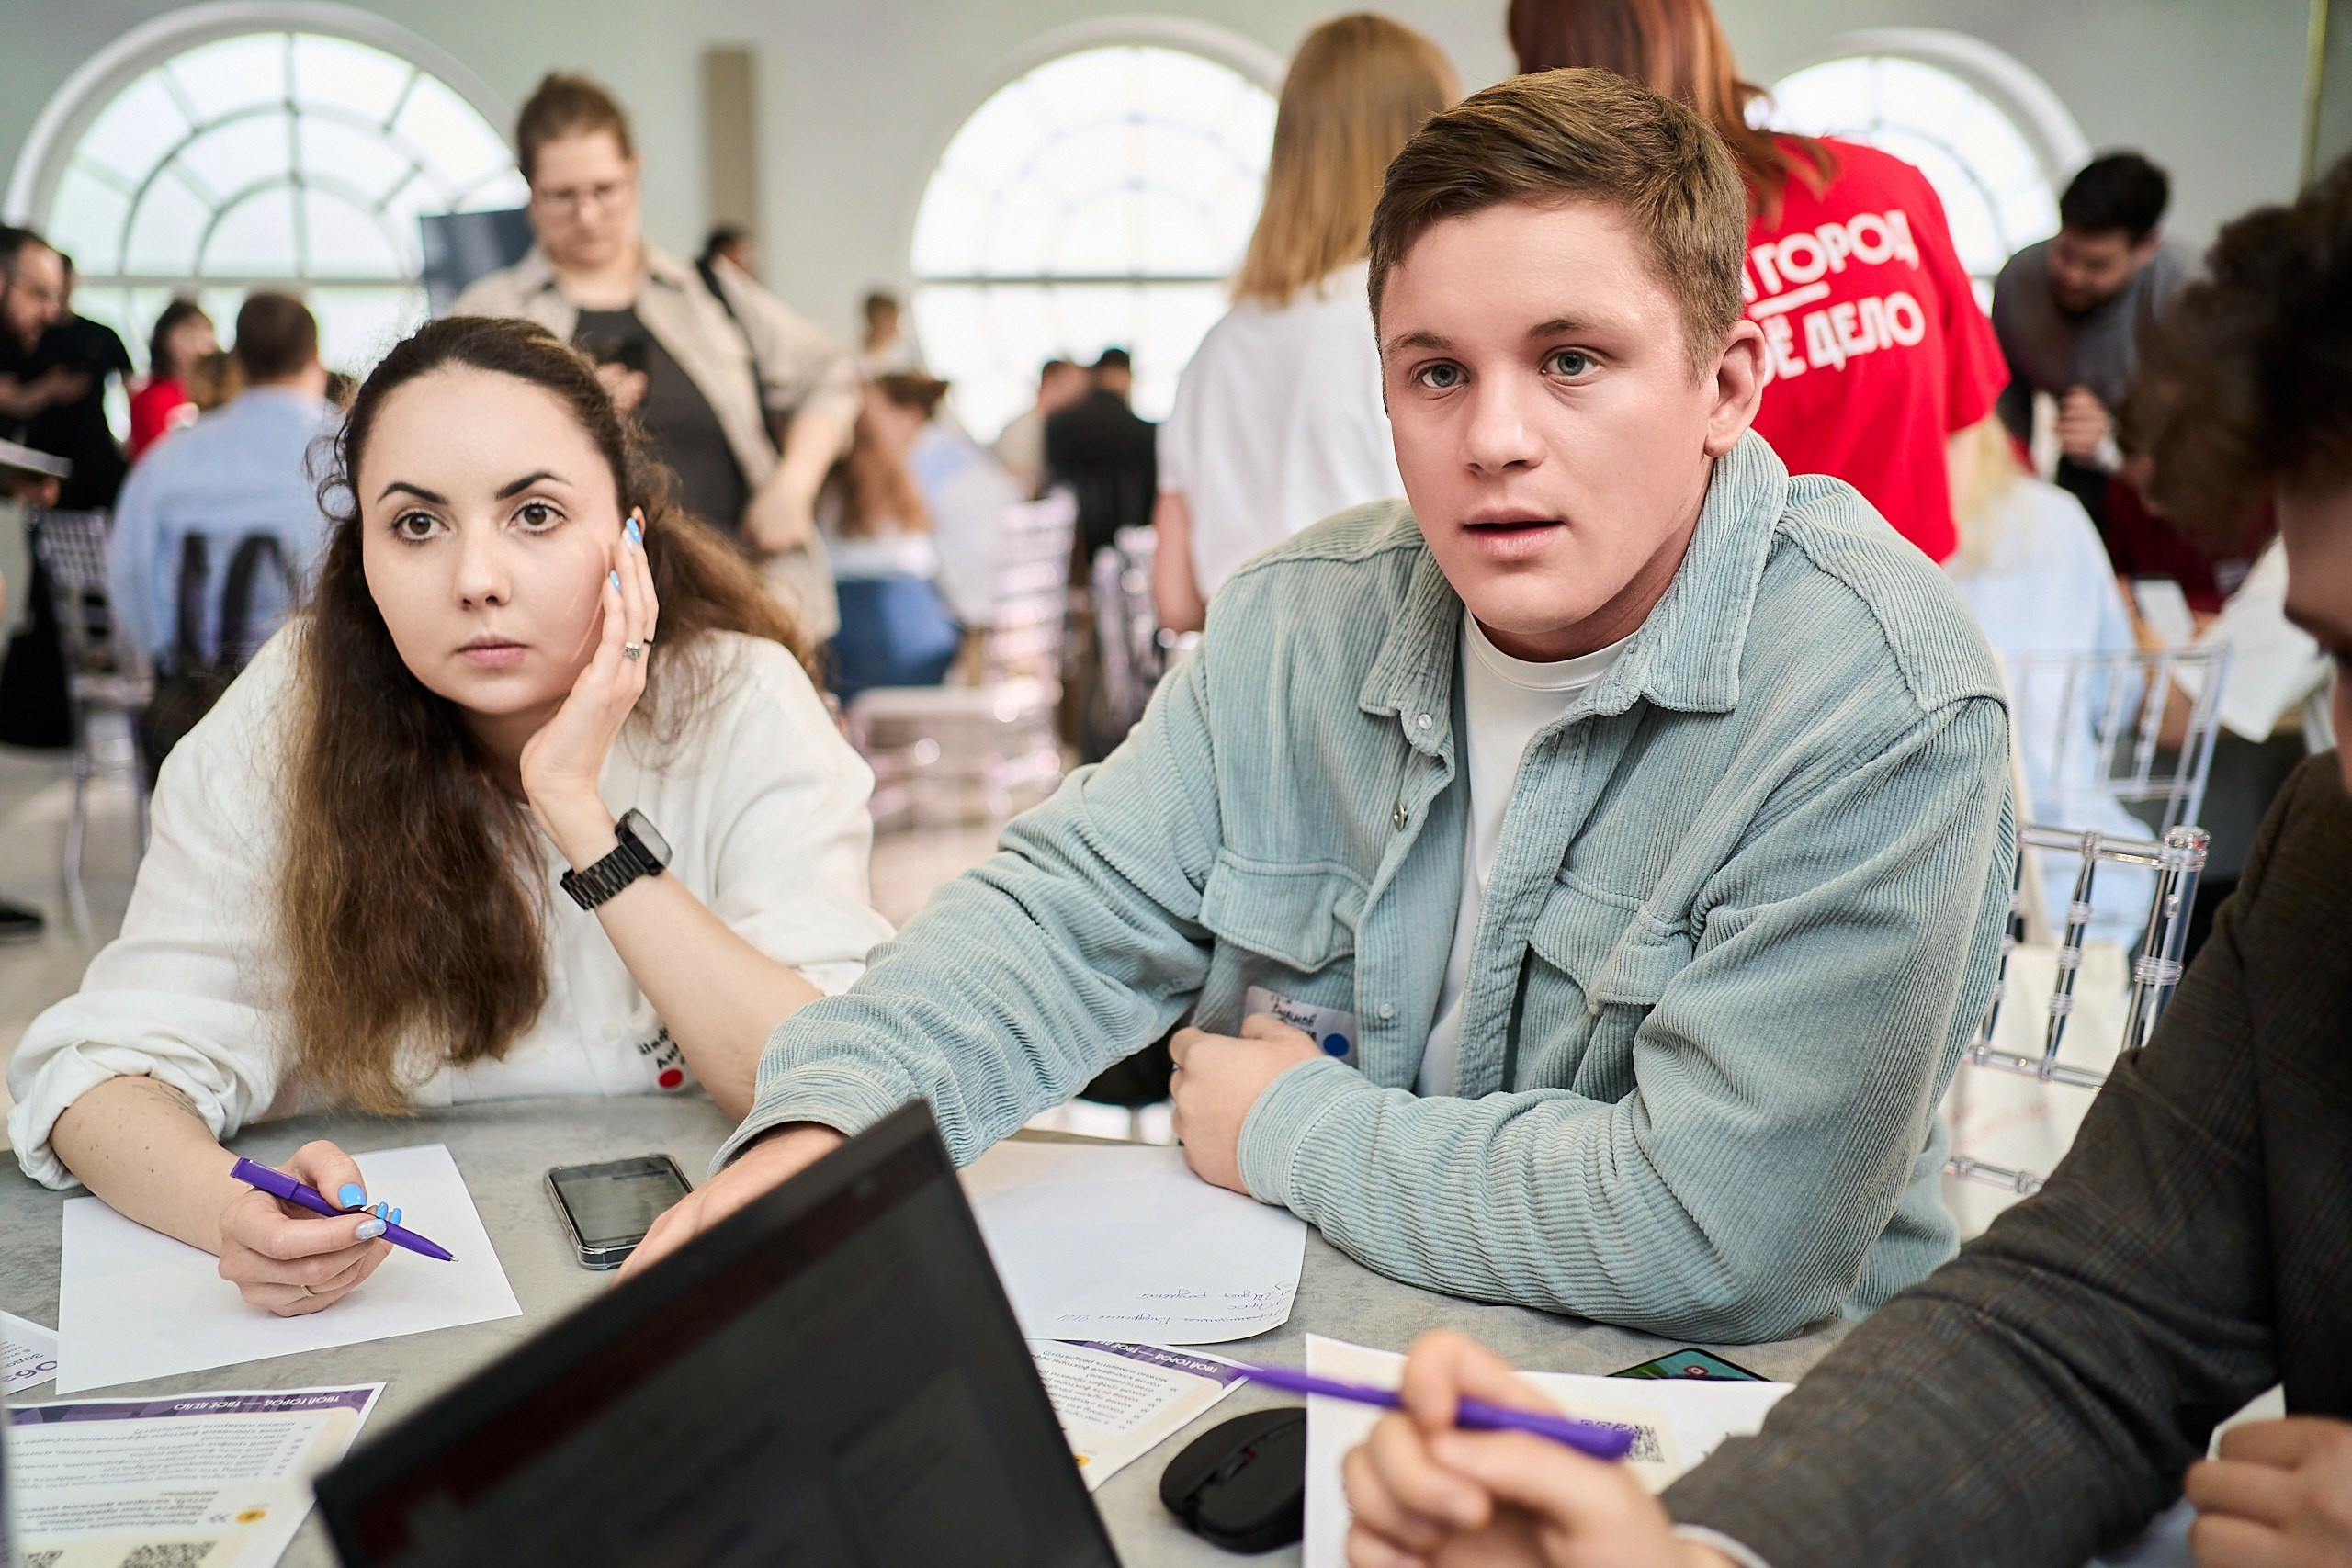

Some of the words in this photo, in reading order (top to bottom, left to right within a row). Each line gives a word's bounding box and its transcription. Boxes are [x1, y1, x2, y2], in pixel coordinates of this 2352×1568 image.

[1750, 209, 1919, 295] ГОРОД
[1803, 291, 1926, 372] ДЕЛО
[1156, 1353, 1191, 1368] ГОРОД
[173, 1402, 208, 1411] ДЕЛО
[263, 1398, 308, 1408] ГОРОД
[307, 1395, 340, 1406] ТВОЙ
